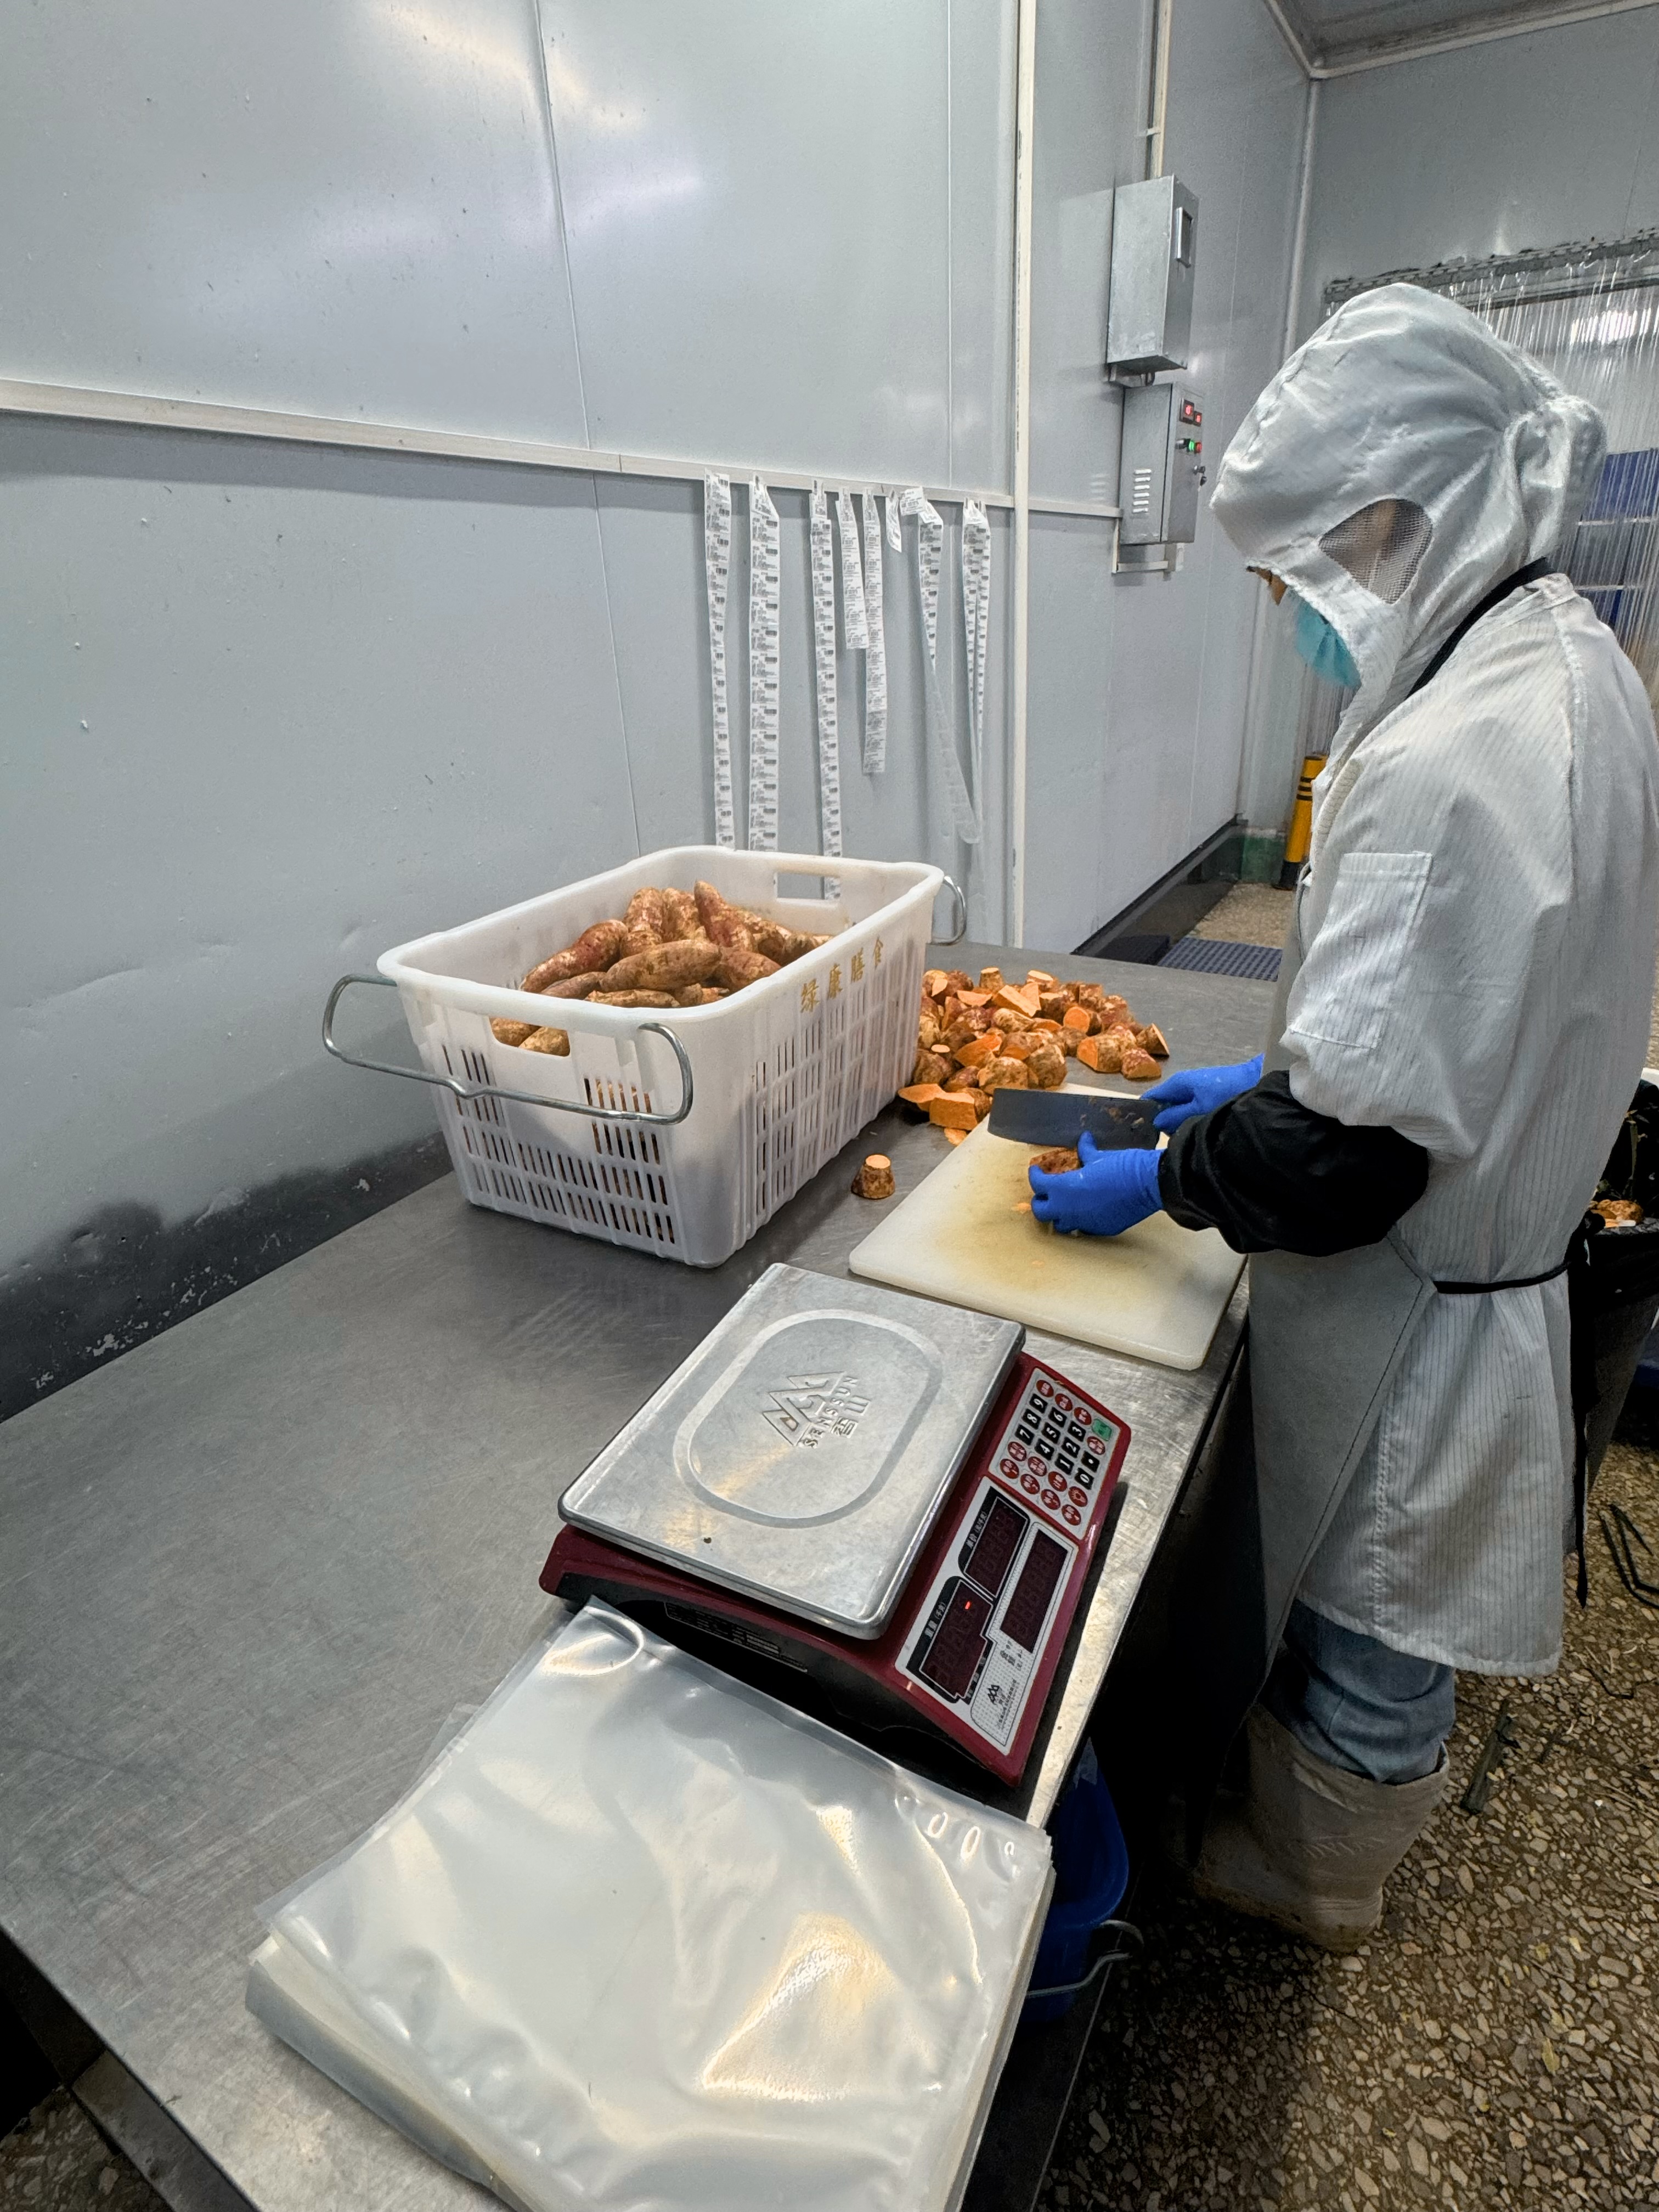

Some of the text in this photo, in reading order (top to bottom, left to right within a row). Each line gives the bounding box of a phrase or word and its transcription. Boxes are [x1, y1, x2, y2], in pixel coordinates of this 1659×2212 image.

[802, 1376, 859, 1448] SENSSUN
[830, 1395, 871, 1438] 香山
[1019, 1398, 1043, 1438] 7 8 9
[1040, 1412, 1063, 1454] 4 5 6
[1060, 1426, 1082, 1469] 1 2 3
[1080, 1474, 1090, 1483] 0
